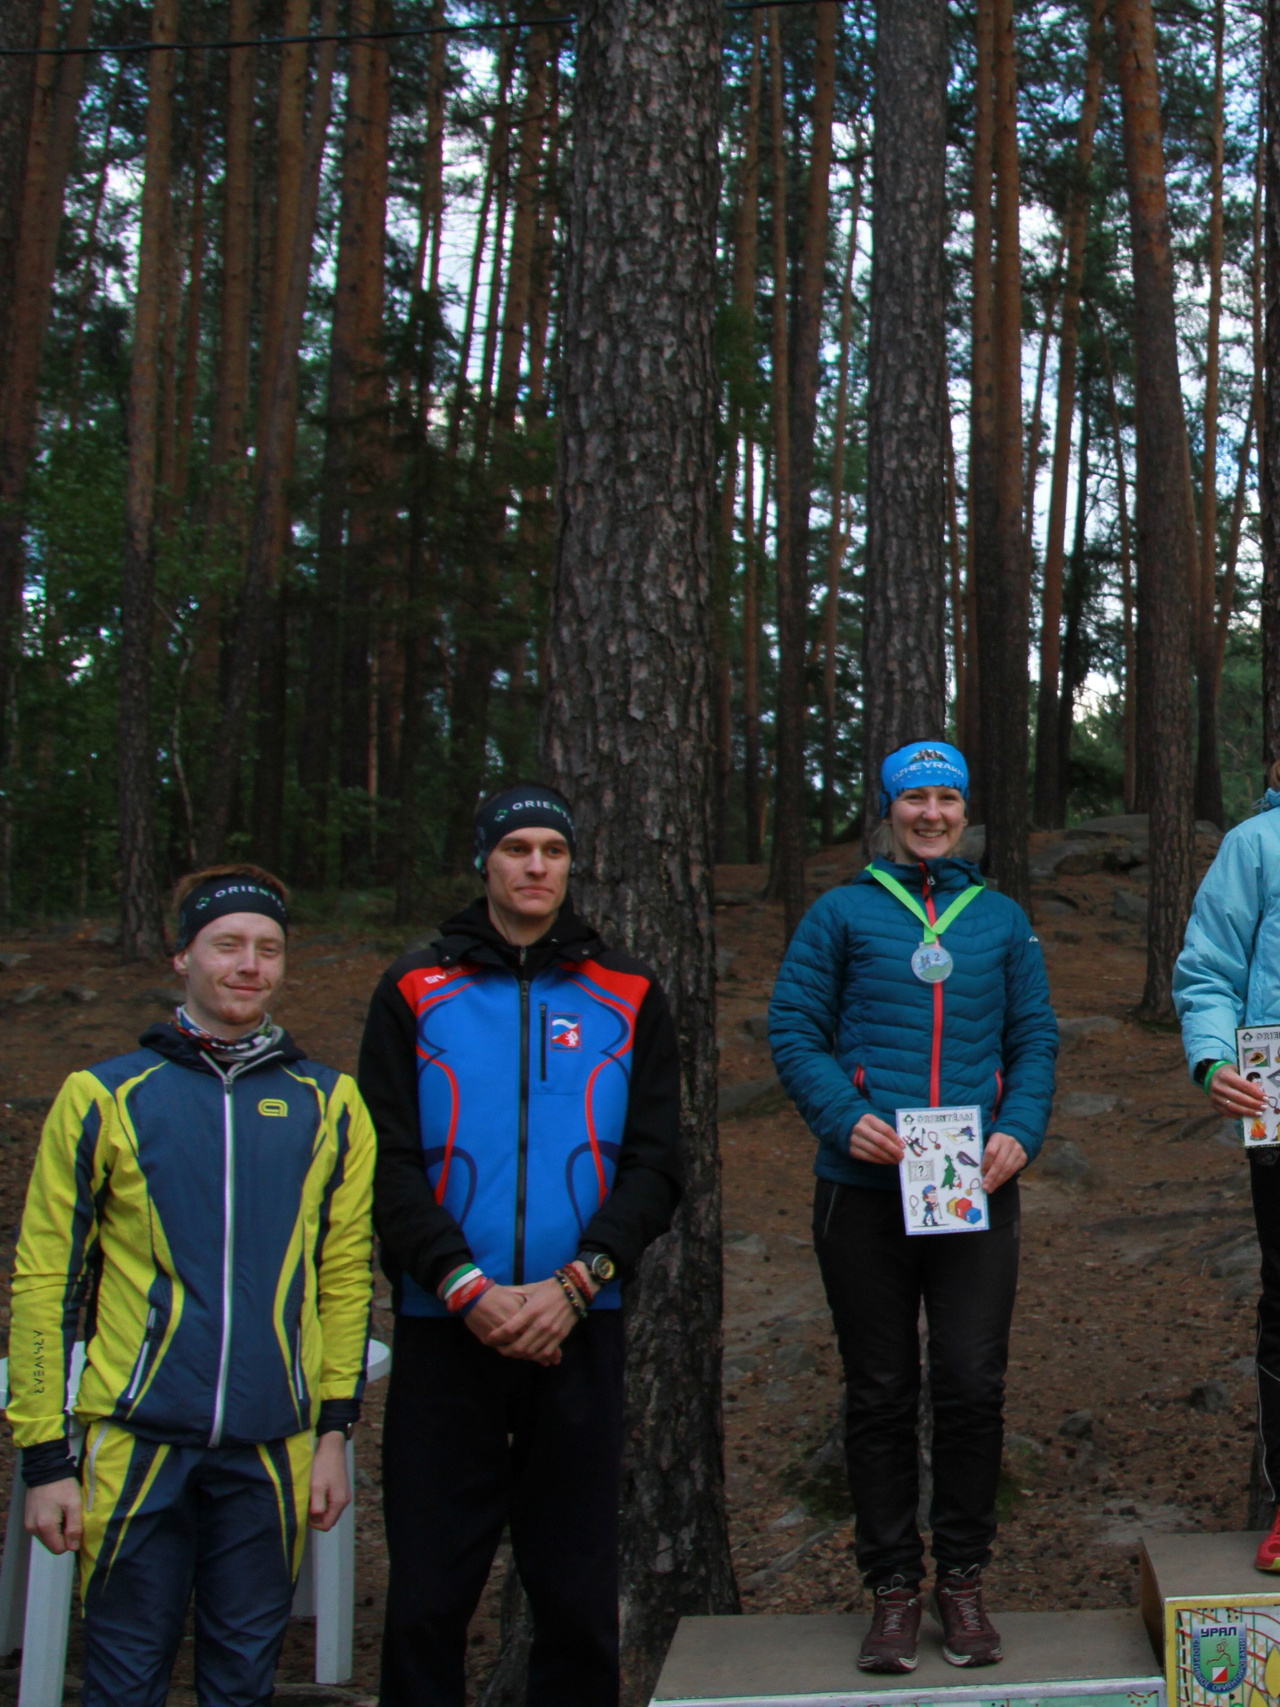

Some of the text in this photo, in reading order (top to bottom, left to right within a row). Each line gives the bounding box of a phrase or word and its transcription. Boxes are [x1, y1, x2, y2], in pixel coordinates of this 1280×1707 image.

[511, 800, 575, 830] ORIENT
[214, 885, 287, 917] ORIENT
[933, 952, 940, 962] 2
[33, 1329, 45, 1394] ARSWEAR
[1200, 1626, 1237, 1638] УРАЛ
